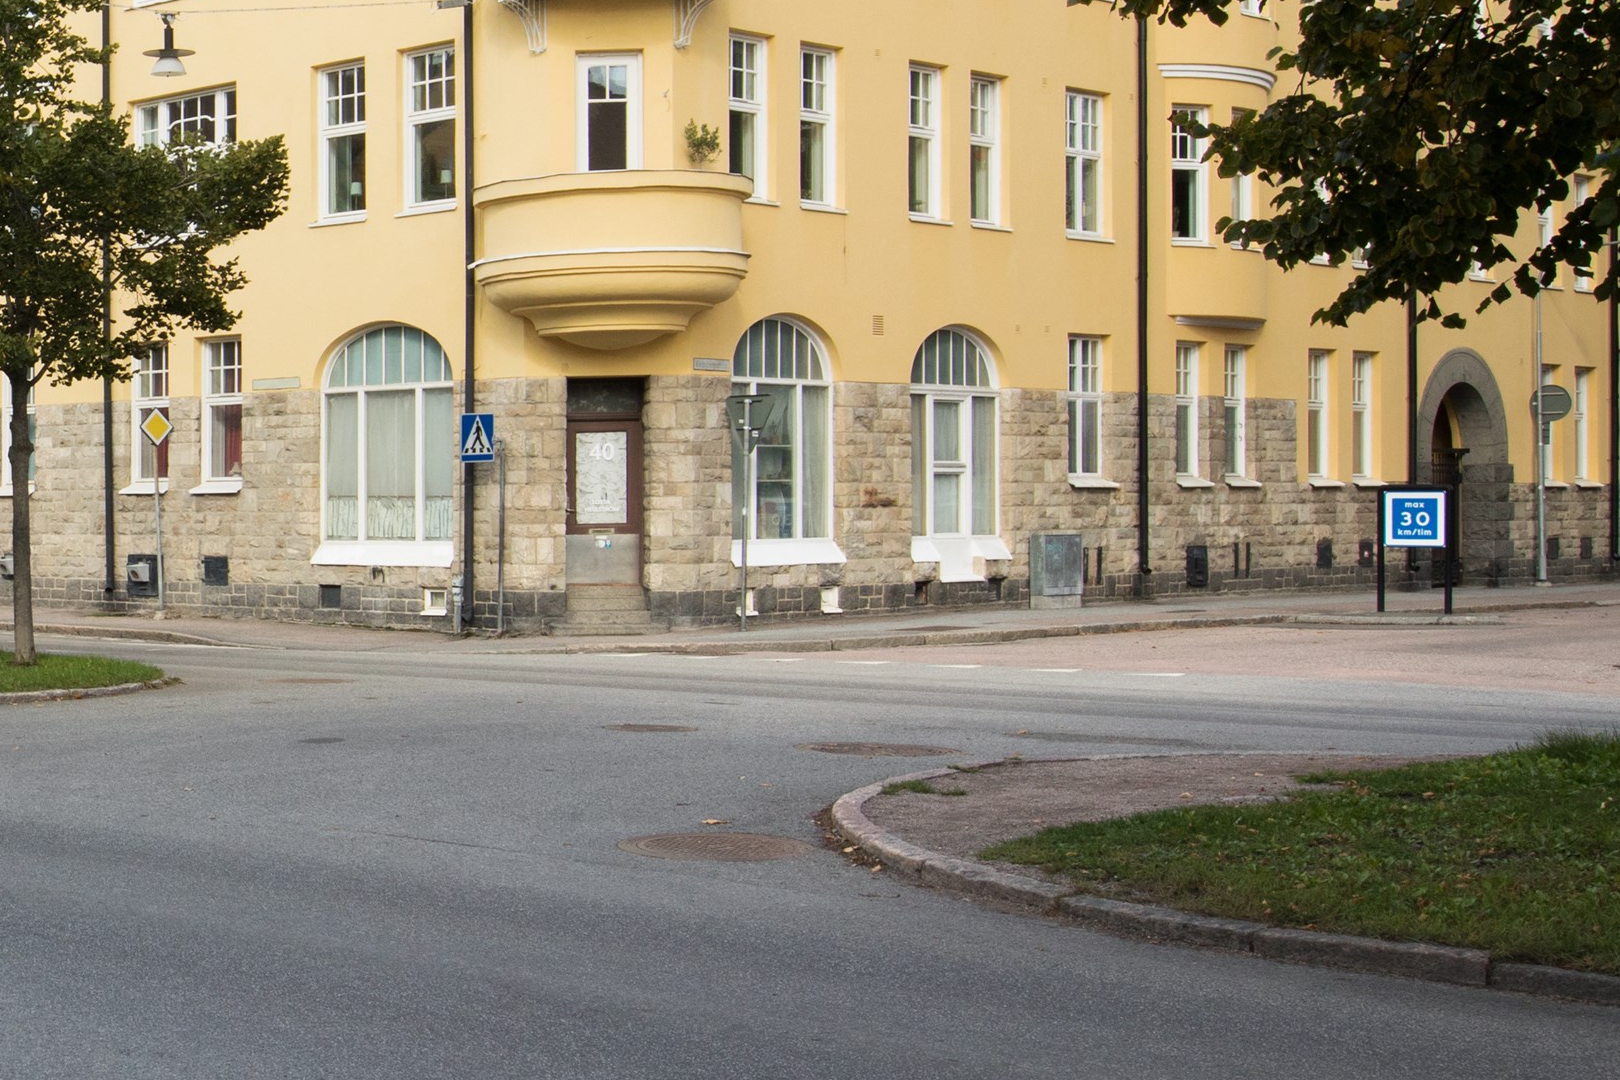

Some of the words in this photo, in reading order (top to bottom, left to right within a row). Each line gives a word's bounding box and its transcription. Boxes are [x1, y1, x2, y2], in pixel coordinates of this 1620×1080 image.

[589, 442, 615, 461] 40
[1400, 511, 1430, 526] 30
[1397, 528, 1432, 536] km/tim
